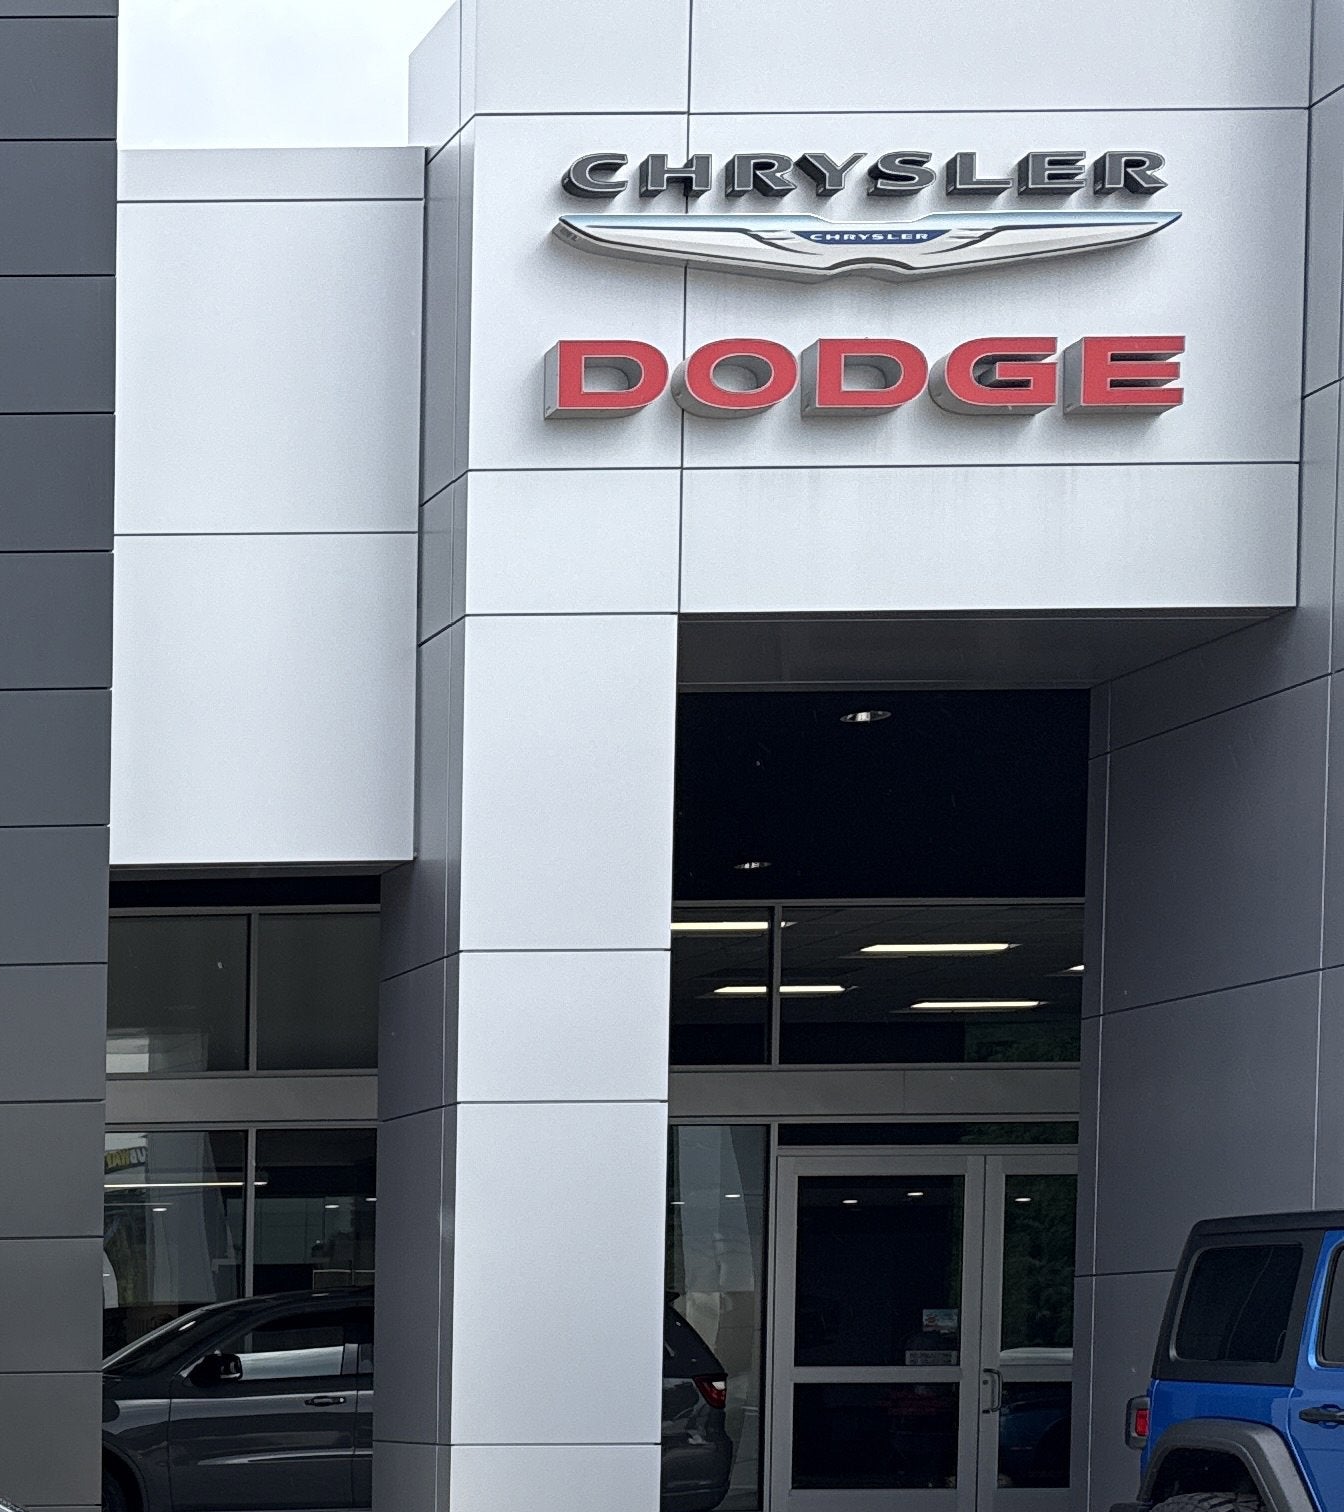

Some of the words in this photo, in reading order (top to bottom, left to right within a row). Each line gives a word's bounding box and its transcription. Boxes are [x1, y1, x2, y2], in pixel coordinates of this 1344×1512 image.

[561, 151, 1166, 197] CHRYSLER
[809, 232, 929, 241] CHRYSLER
[544, 334, 1186, 419] DODGE
